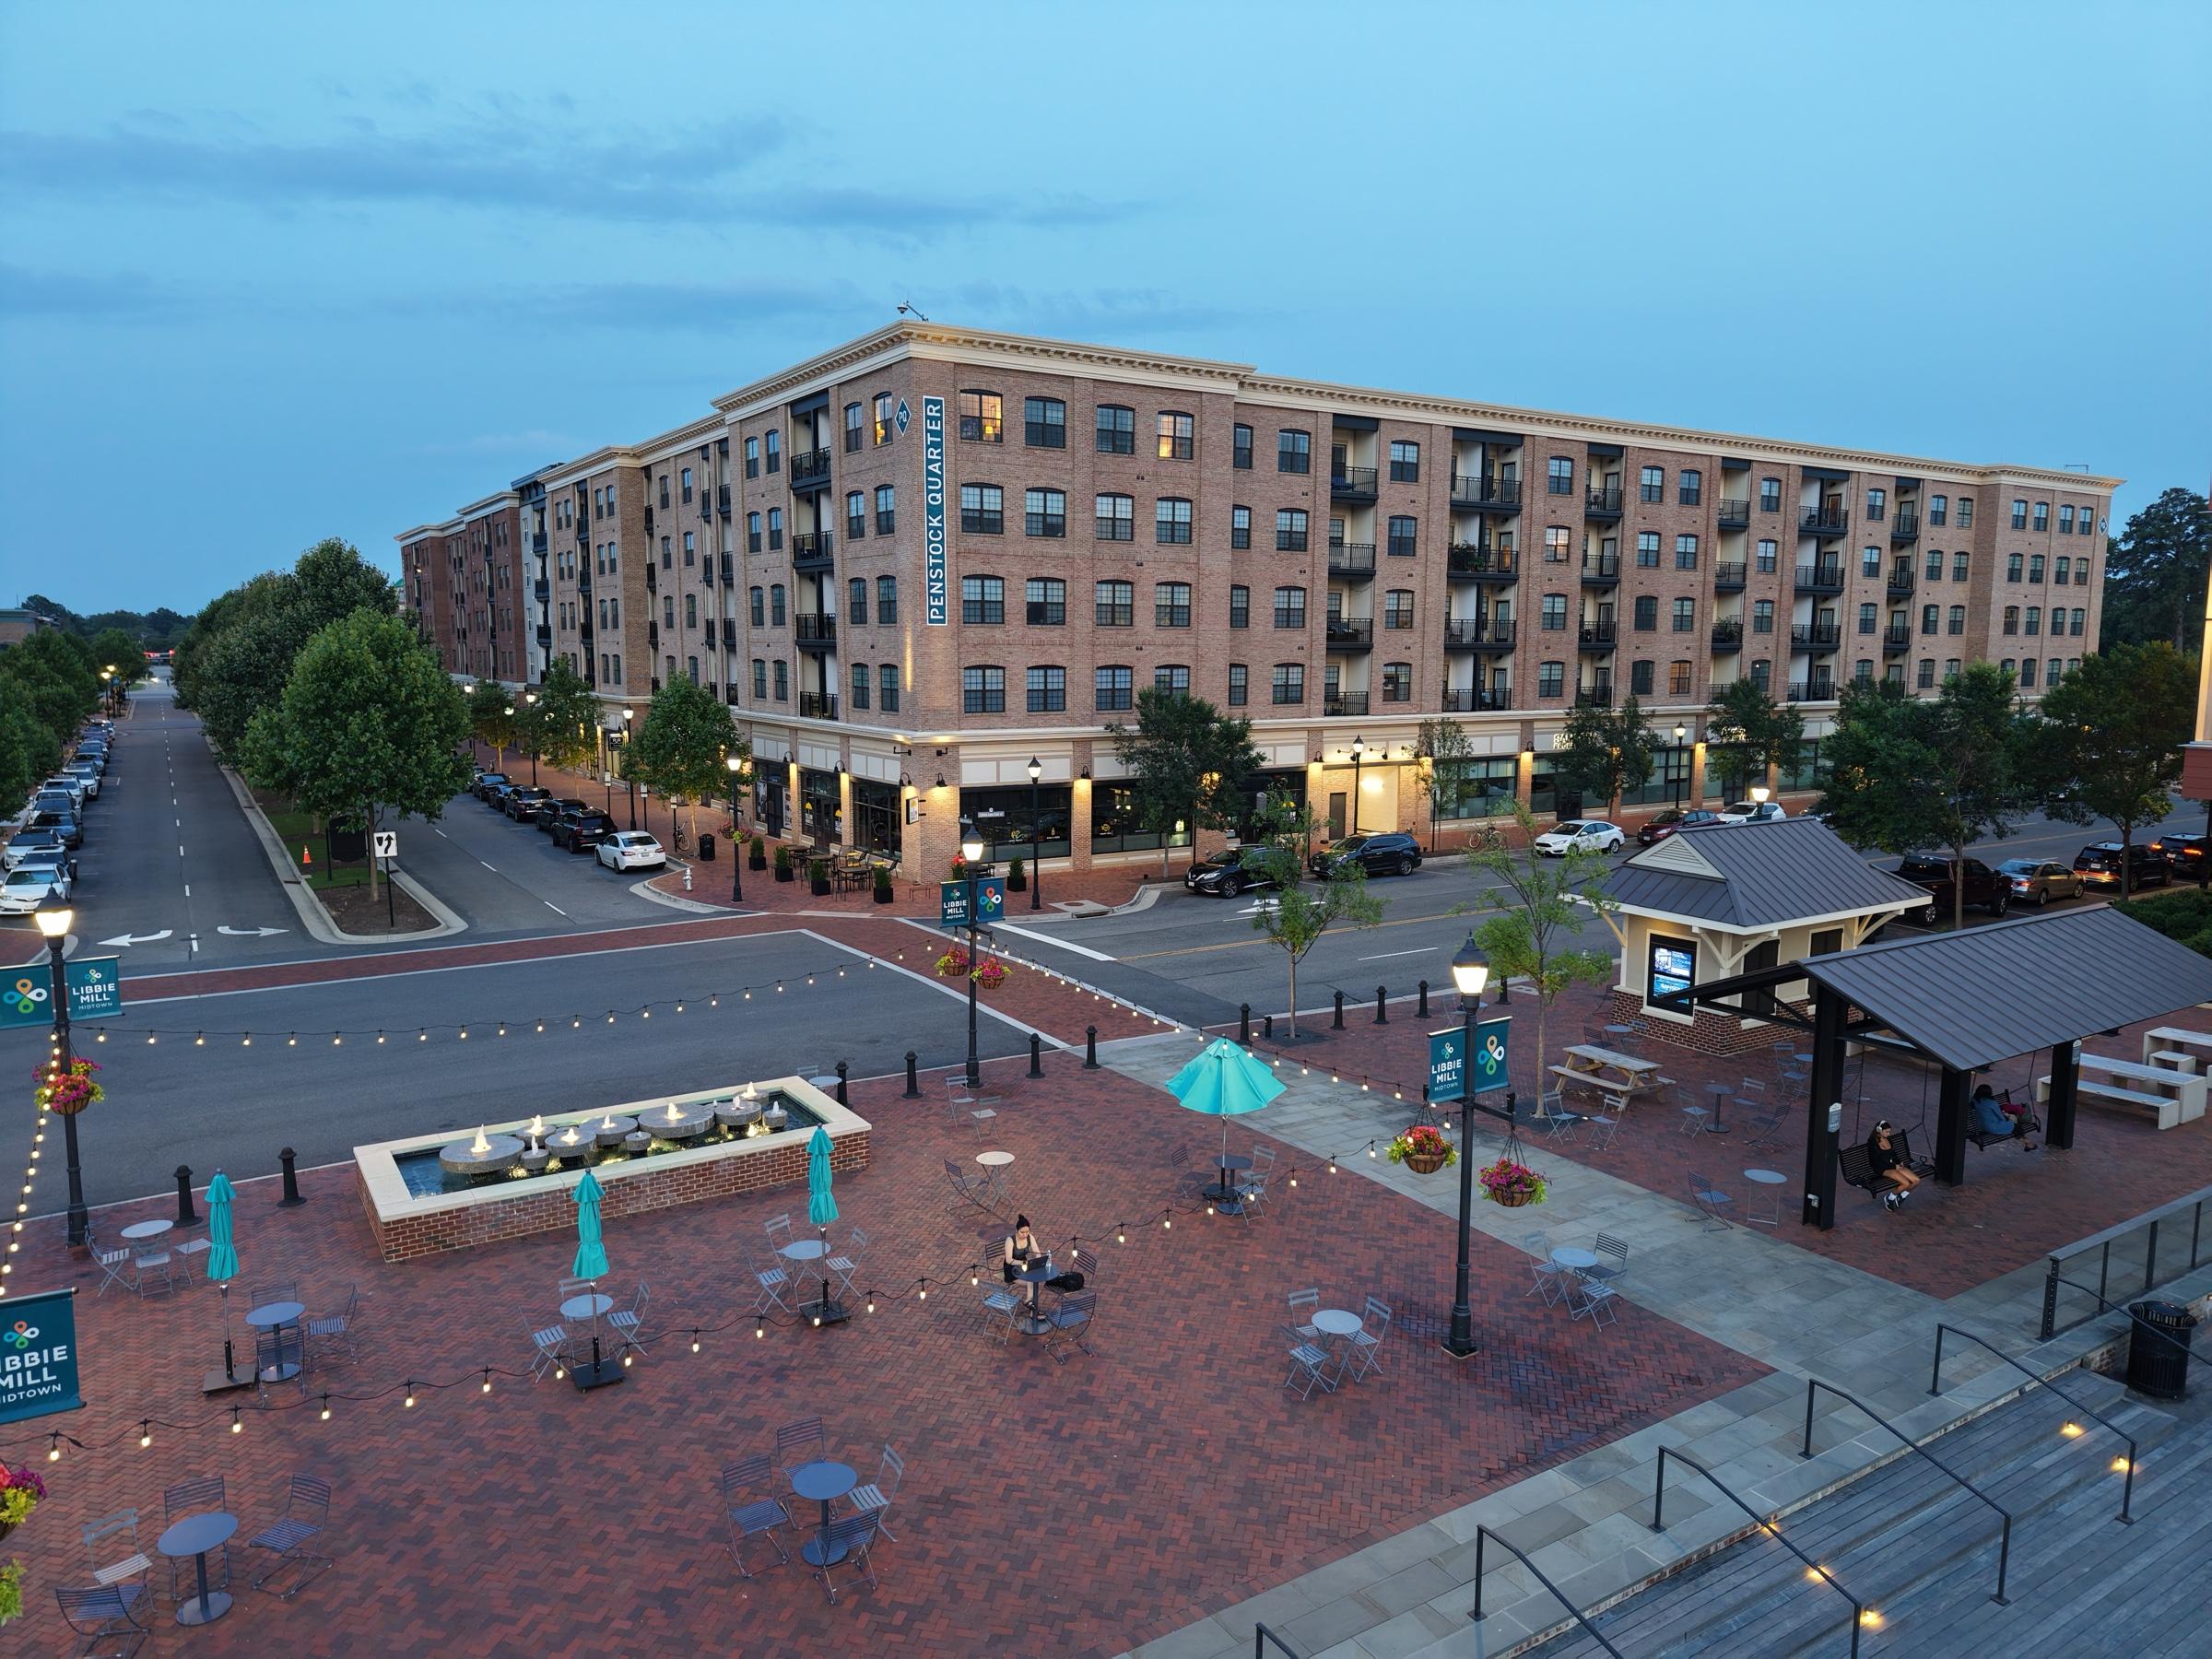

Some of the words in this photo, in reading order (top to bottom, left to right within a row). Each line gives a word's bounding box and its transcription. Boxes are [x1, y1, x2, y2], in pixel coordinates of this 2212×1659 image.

[899, 410, 907, 424] PQ
[926, 404, 942, 505] QUARTER
[928, 514, 944, 619] PENSTOCK
[72, 983, 116, 995] LIBBIE
[80, 993, 111, 1004] MILL
[78, 1002, 112, 1010] MIDTOWN
[1431, 1058, 1462, 1074] LIBBIE
[1436, 1071, 1457, 1084] MILL
[1434, 1082, 1458, 1091] MIDTOWN
